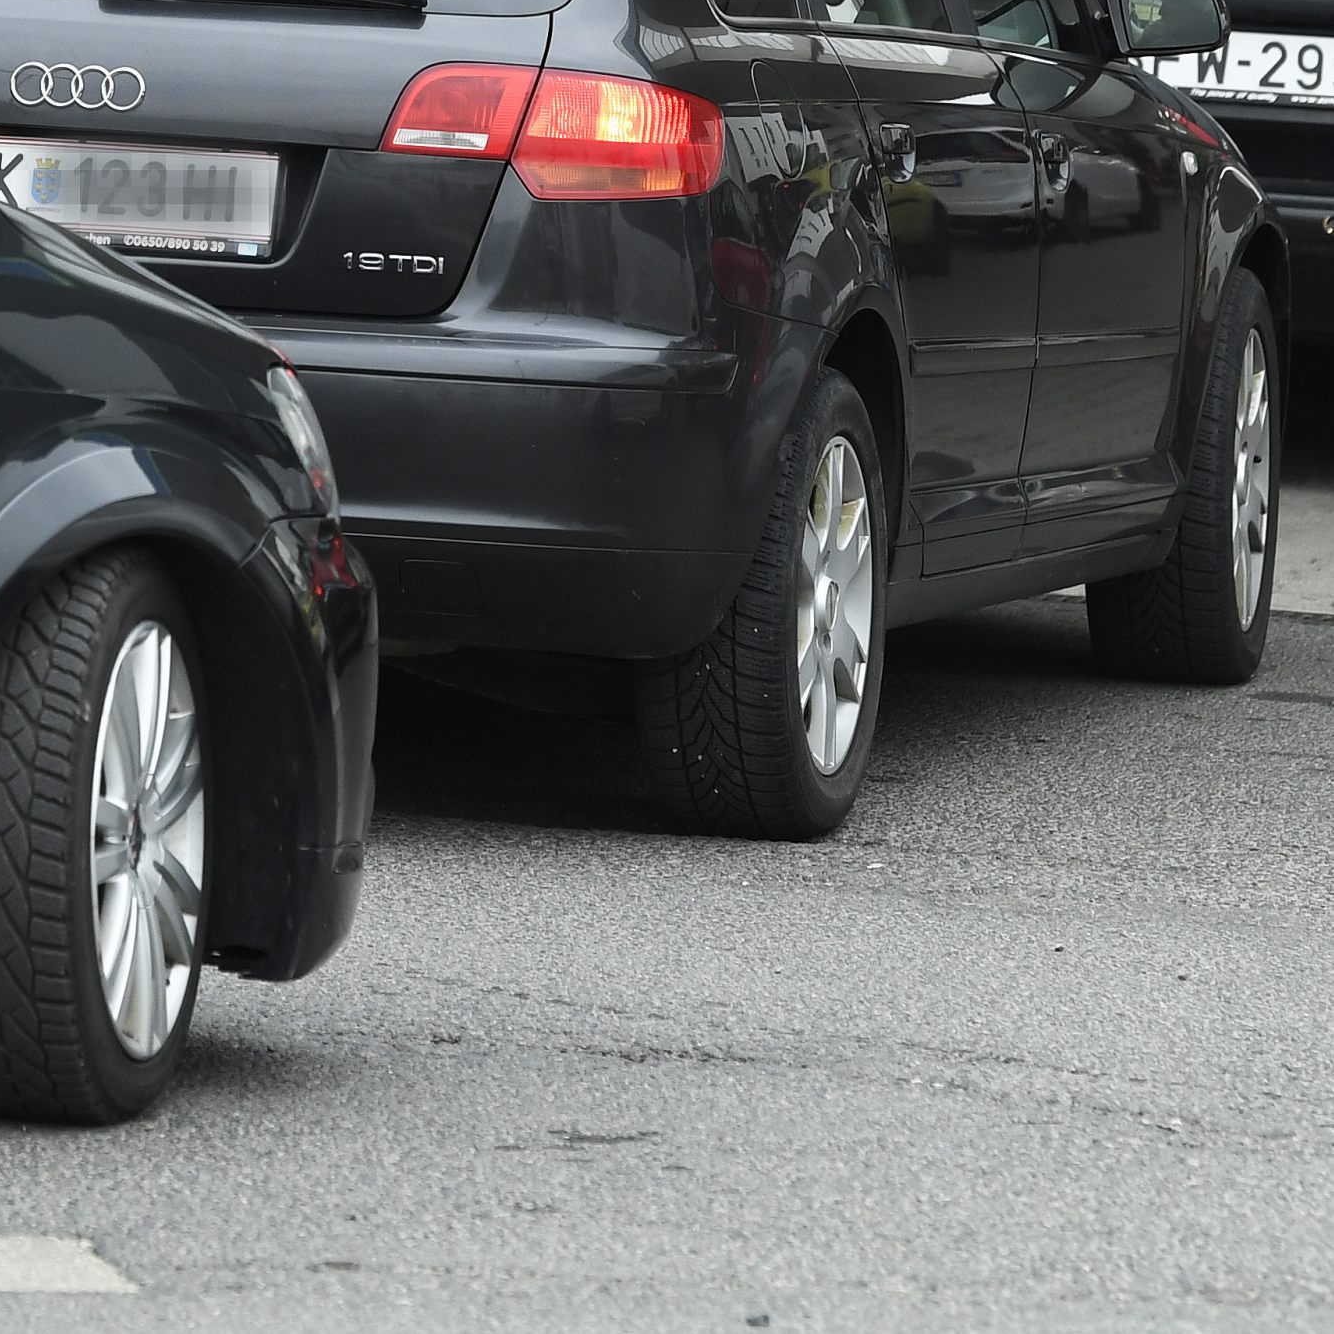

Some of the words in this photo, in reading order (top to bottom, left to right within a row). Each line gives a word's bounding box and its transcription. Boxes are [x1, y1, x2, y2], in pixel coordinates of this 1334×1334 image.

[73, 156, 167, 218] 123
[192, 238, 209, 251] 50
[209, 240, 226, 253] 39
